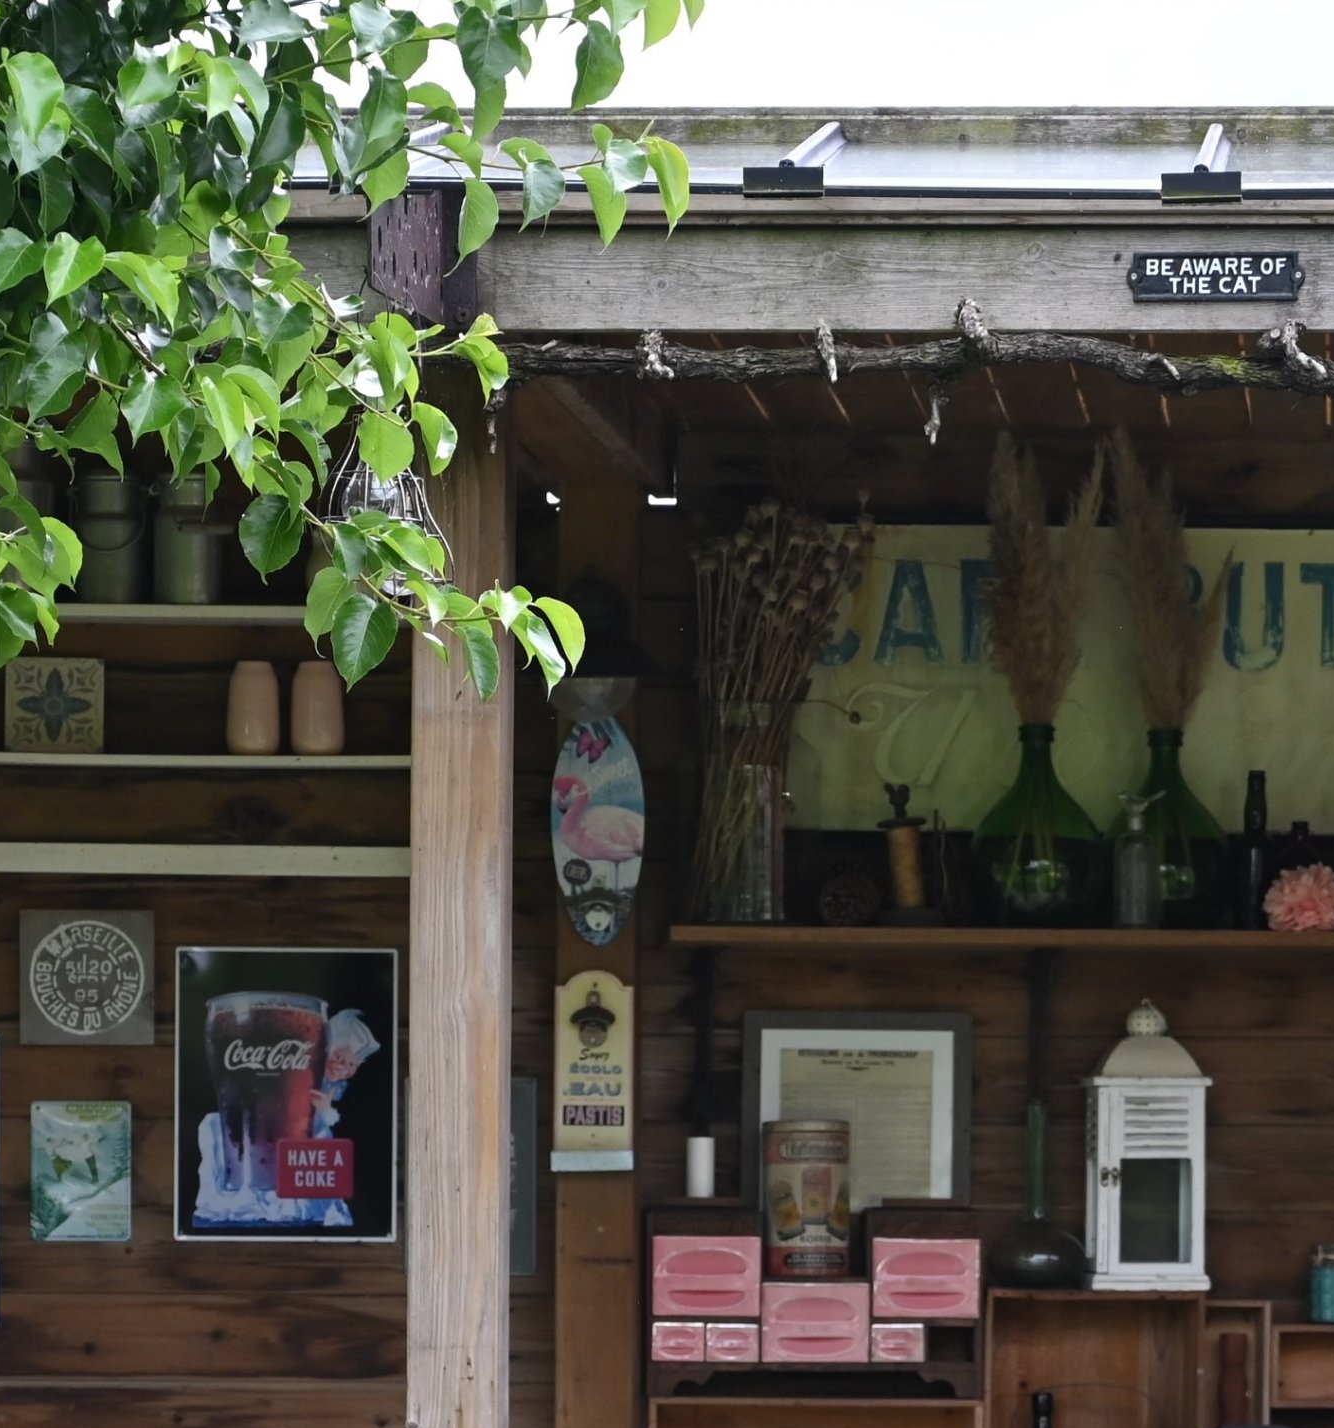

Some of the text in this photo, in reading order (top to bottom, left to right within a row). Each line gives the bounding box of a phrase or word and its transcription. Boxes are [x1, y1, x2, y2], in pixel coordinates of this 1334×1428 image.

[1145, 257, 1287, 276] BE AWARE OF
[1169, 276, 1262, 294] THE CAT
[223, 1038, 315, 1071] Coca-Cola
[566, 1106, 620, 1126] PASTIS
[287, 1150, 344, 1167] HAVE A
[294, 1170, 336, 1188] COKE
